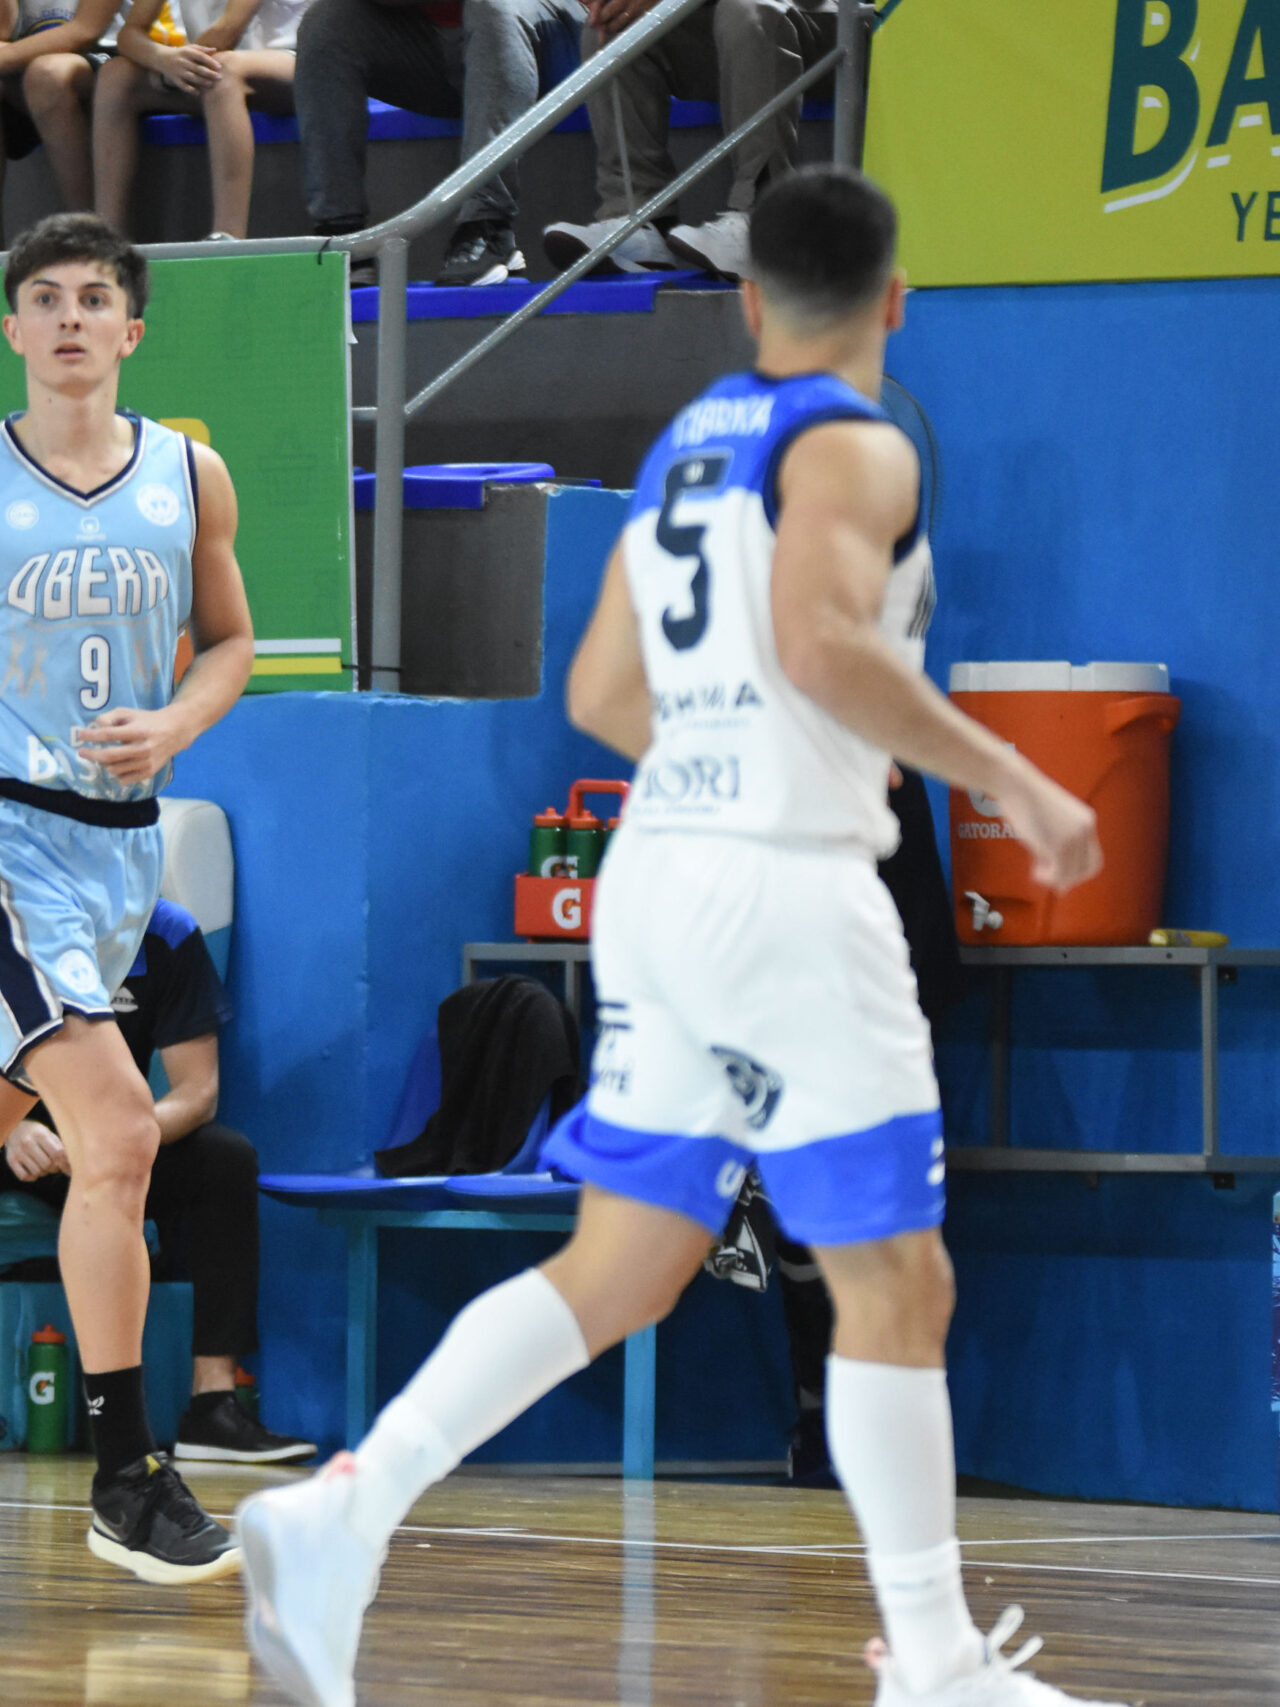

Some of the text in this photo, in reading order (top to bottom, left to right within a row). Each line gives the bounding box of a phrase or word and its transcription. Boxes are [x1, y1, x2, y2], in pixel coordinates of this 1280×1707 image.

[1231, 191, 1280, 242] YE
[657, 447, 734, 652] 5
[80, 634, 111, 710] 9
[552, 887, 582, 930] G
[30, 1372, 55, 1405] G
